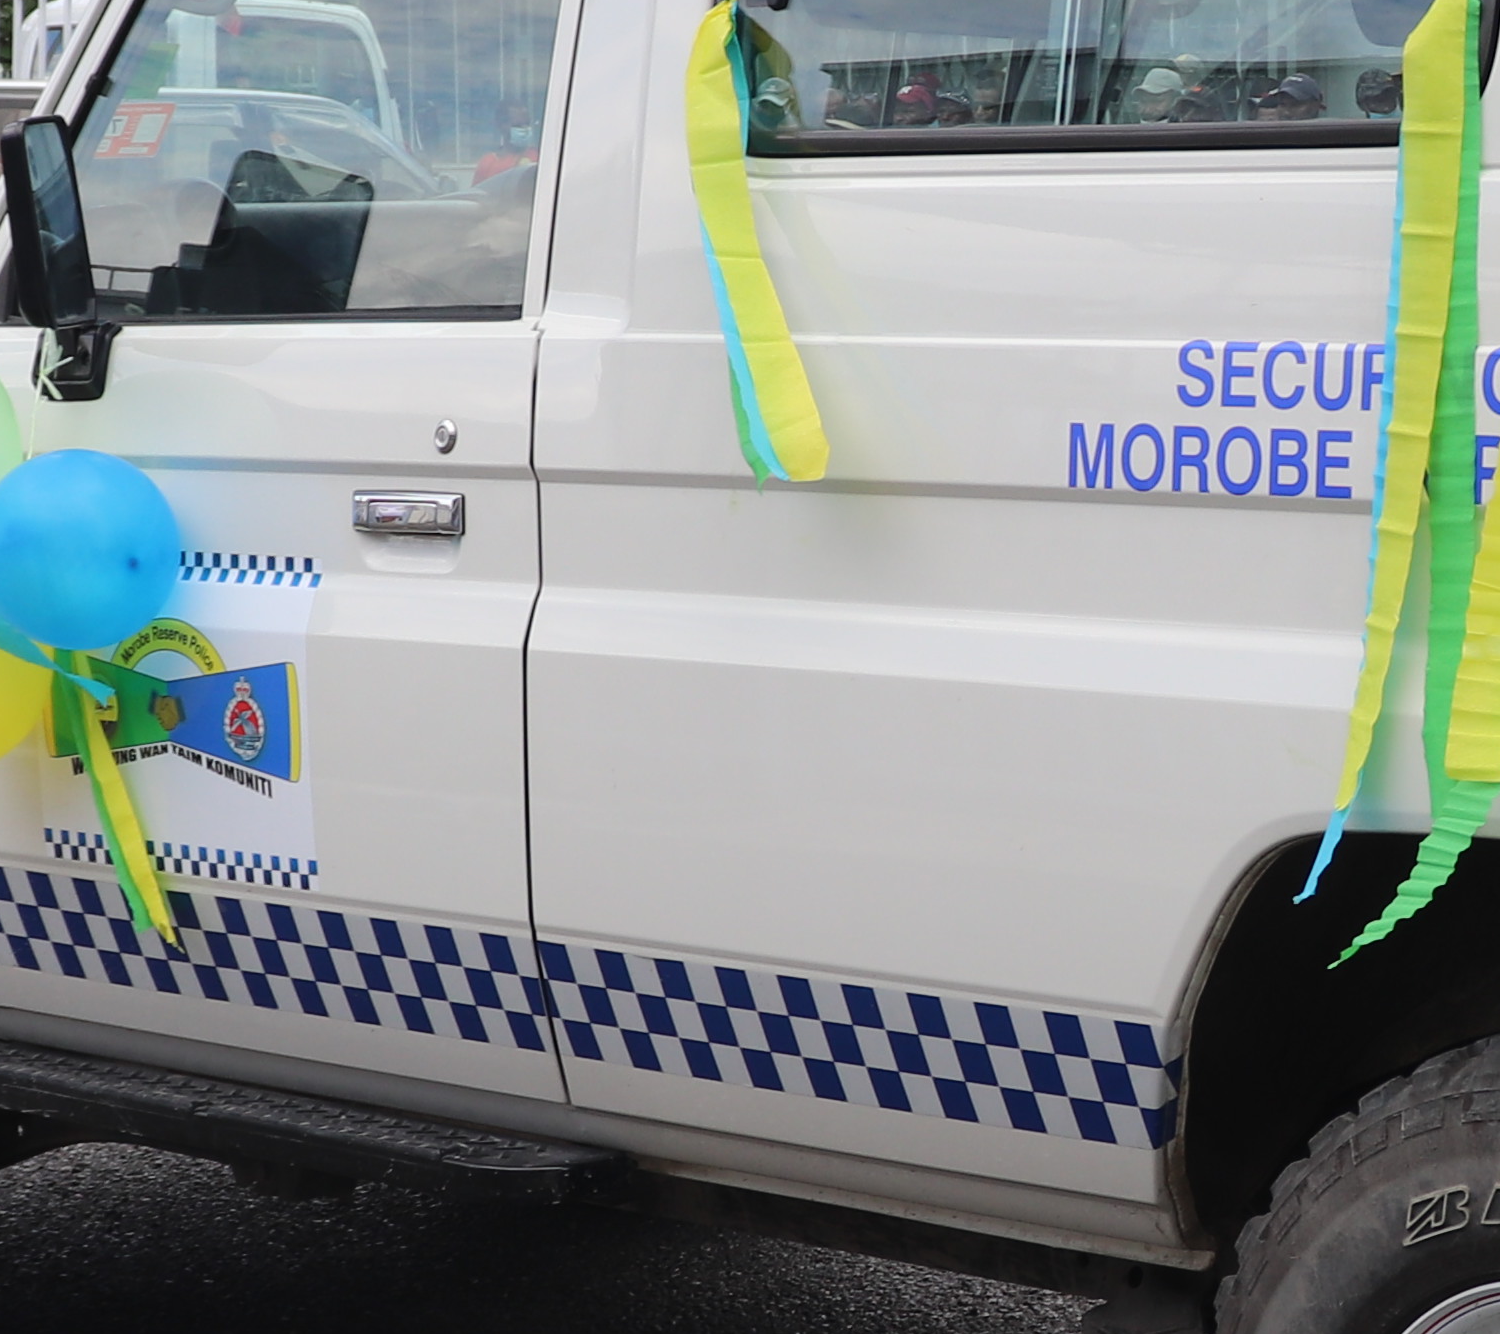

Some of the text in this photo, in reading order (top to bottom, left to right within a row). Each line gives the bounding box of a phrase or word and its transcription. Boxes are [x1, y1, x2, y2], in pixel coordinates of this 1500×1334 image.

[1068, 422, 1354, 499] MOROBE
[120, 630, 152, 665] Morobe
[151, 625, 189, 646] Reserve
[205, 756, 274, 799] KOMUNITI
